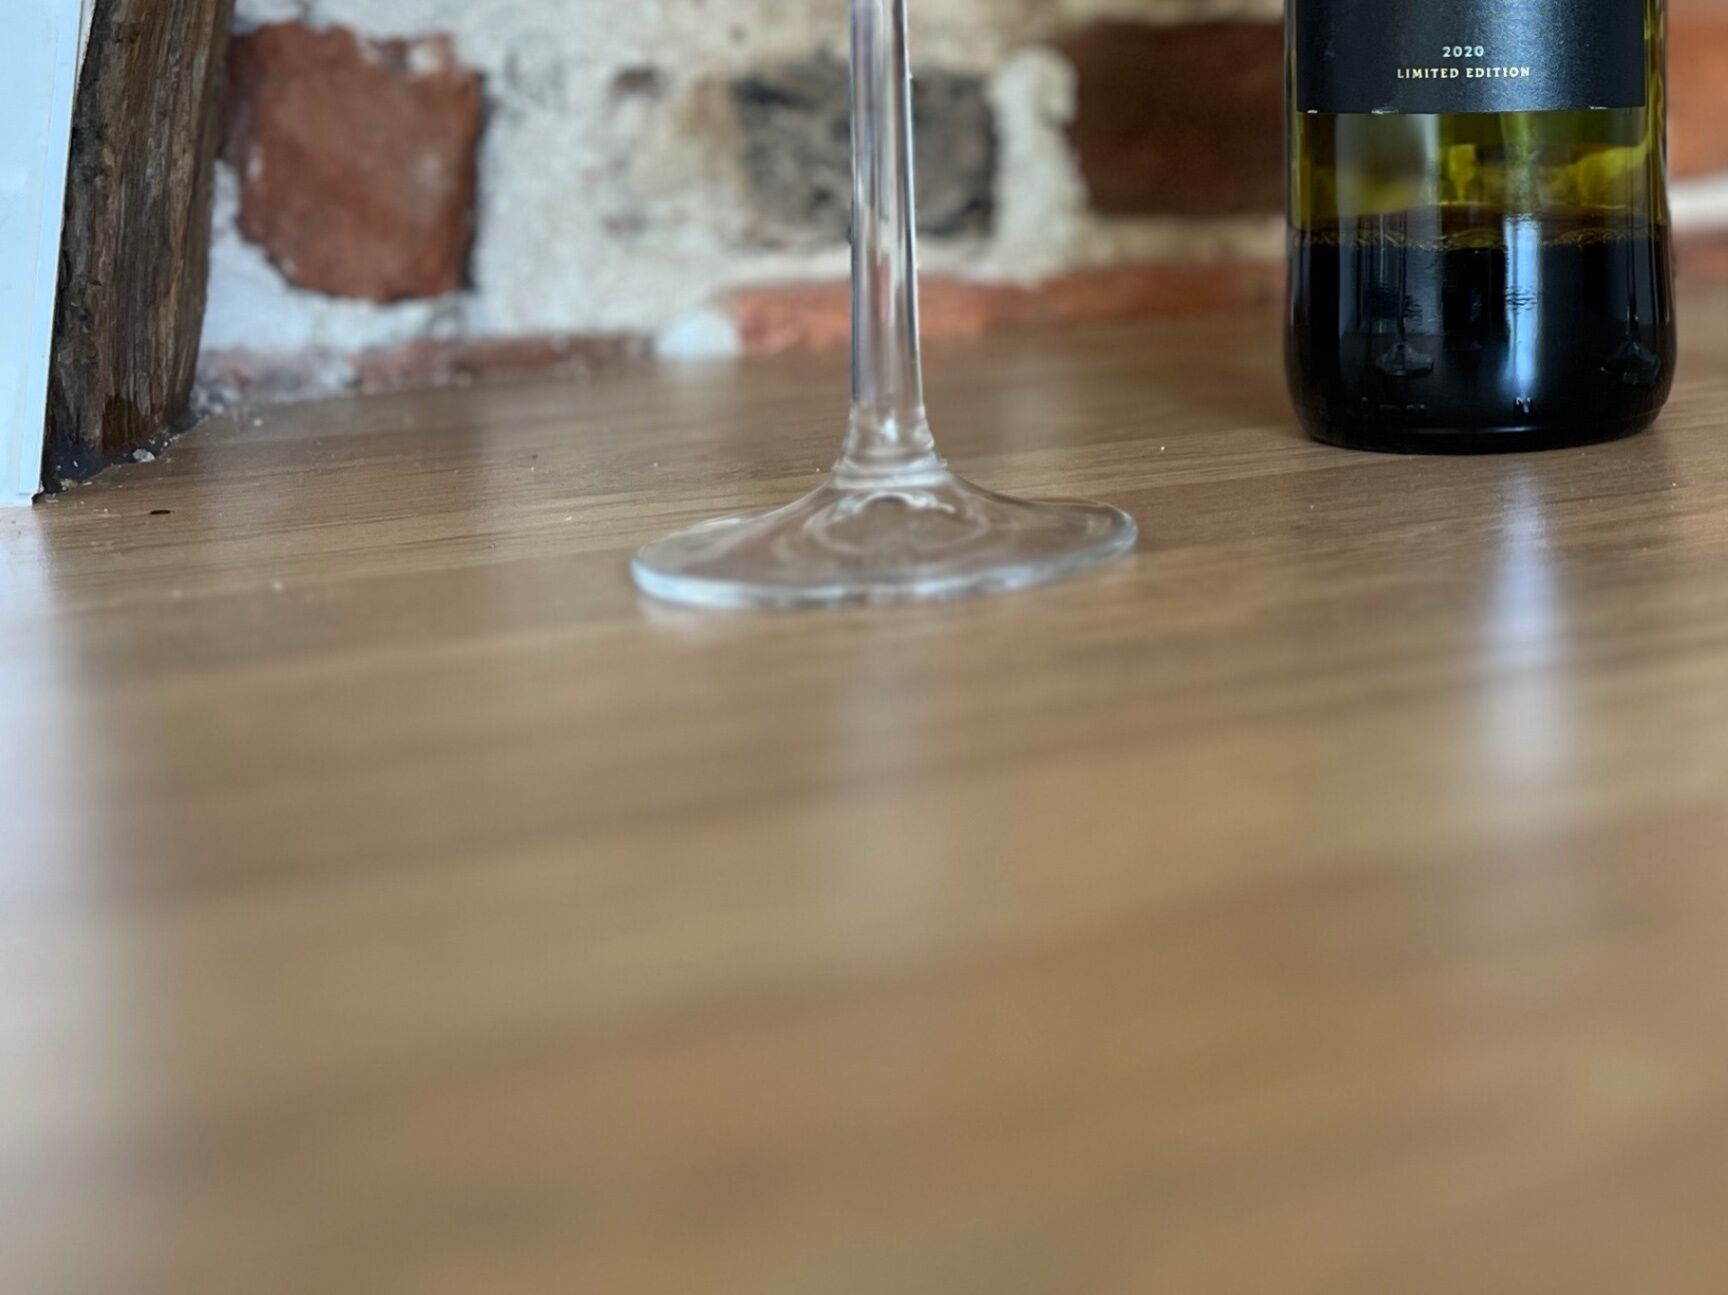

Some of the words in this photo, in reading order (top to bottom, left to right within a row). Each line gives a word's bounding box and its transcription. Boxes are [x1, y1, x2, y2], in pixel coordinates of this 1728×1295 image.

[1442, 45, 1485, 58] 2020
[1397, 67, 1460, 79] LIMITED
[1466, 66, 1530, 79] EDITION
